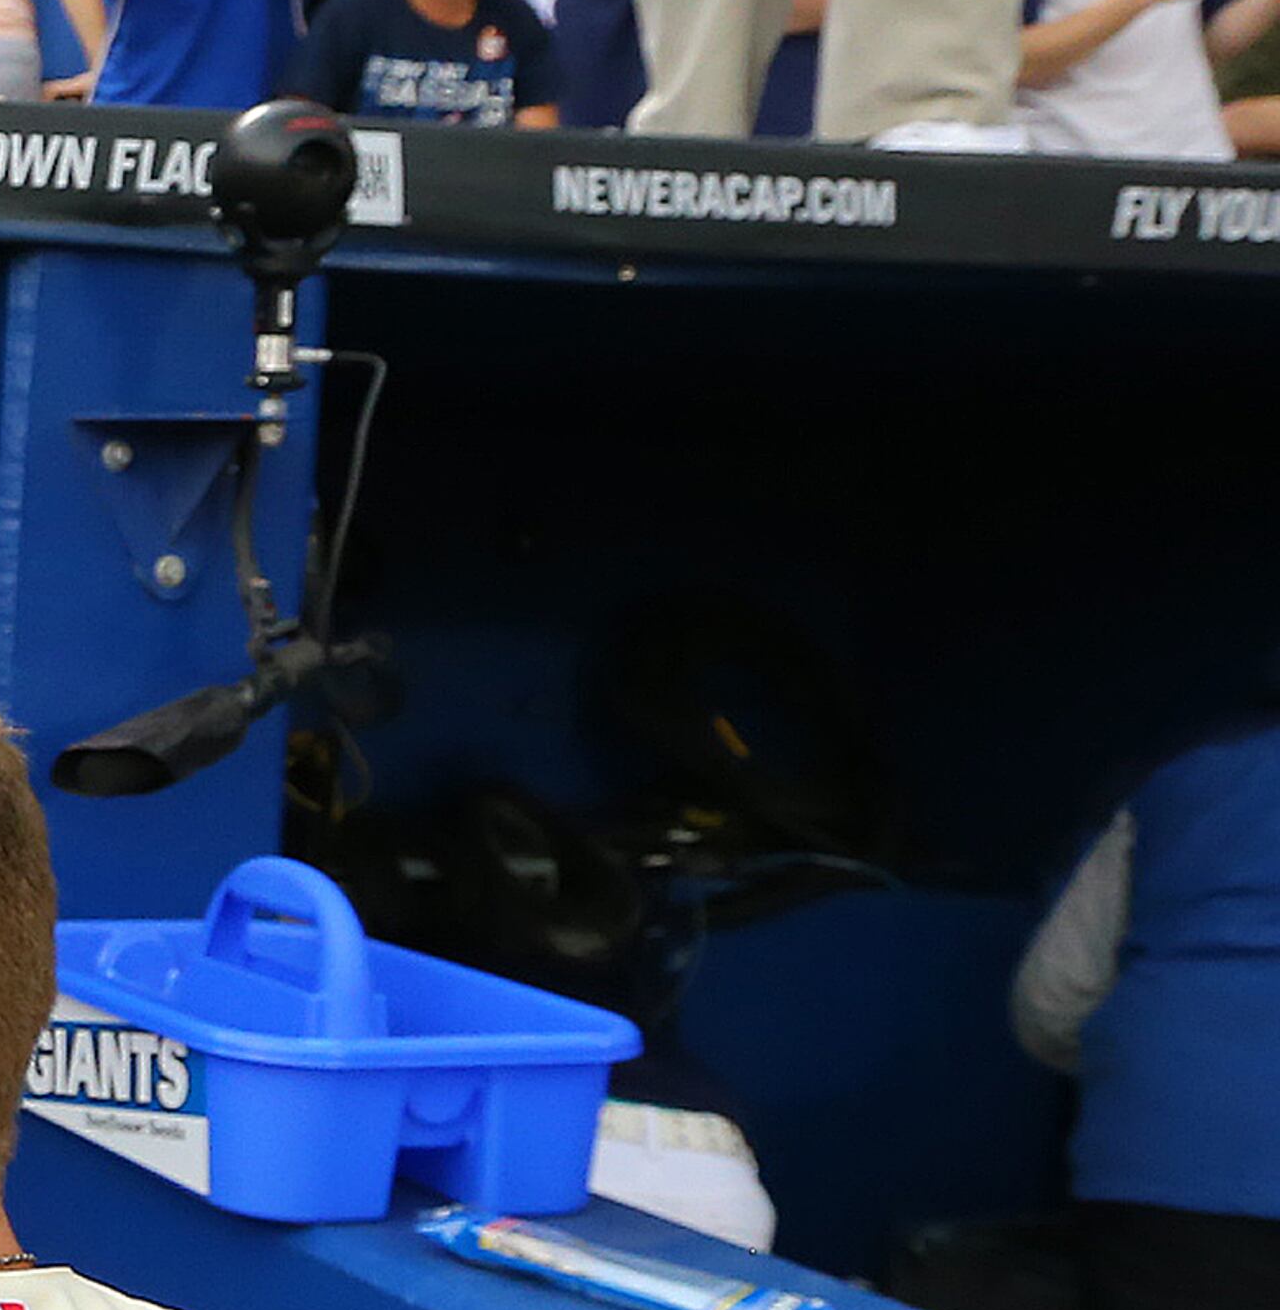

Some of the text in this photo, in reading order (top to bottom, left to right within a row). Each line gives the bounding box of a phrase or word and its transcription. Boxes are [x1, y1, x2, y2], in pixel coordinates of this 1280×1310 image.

[552, 165, 898, 228] NEWERACAP.COM
[1109, 185, 1198, 240] FLY
[26, 1027, 190, 1111] GIANTS
